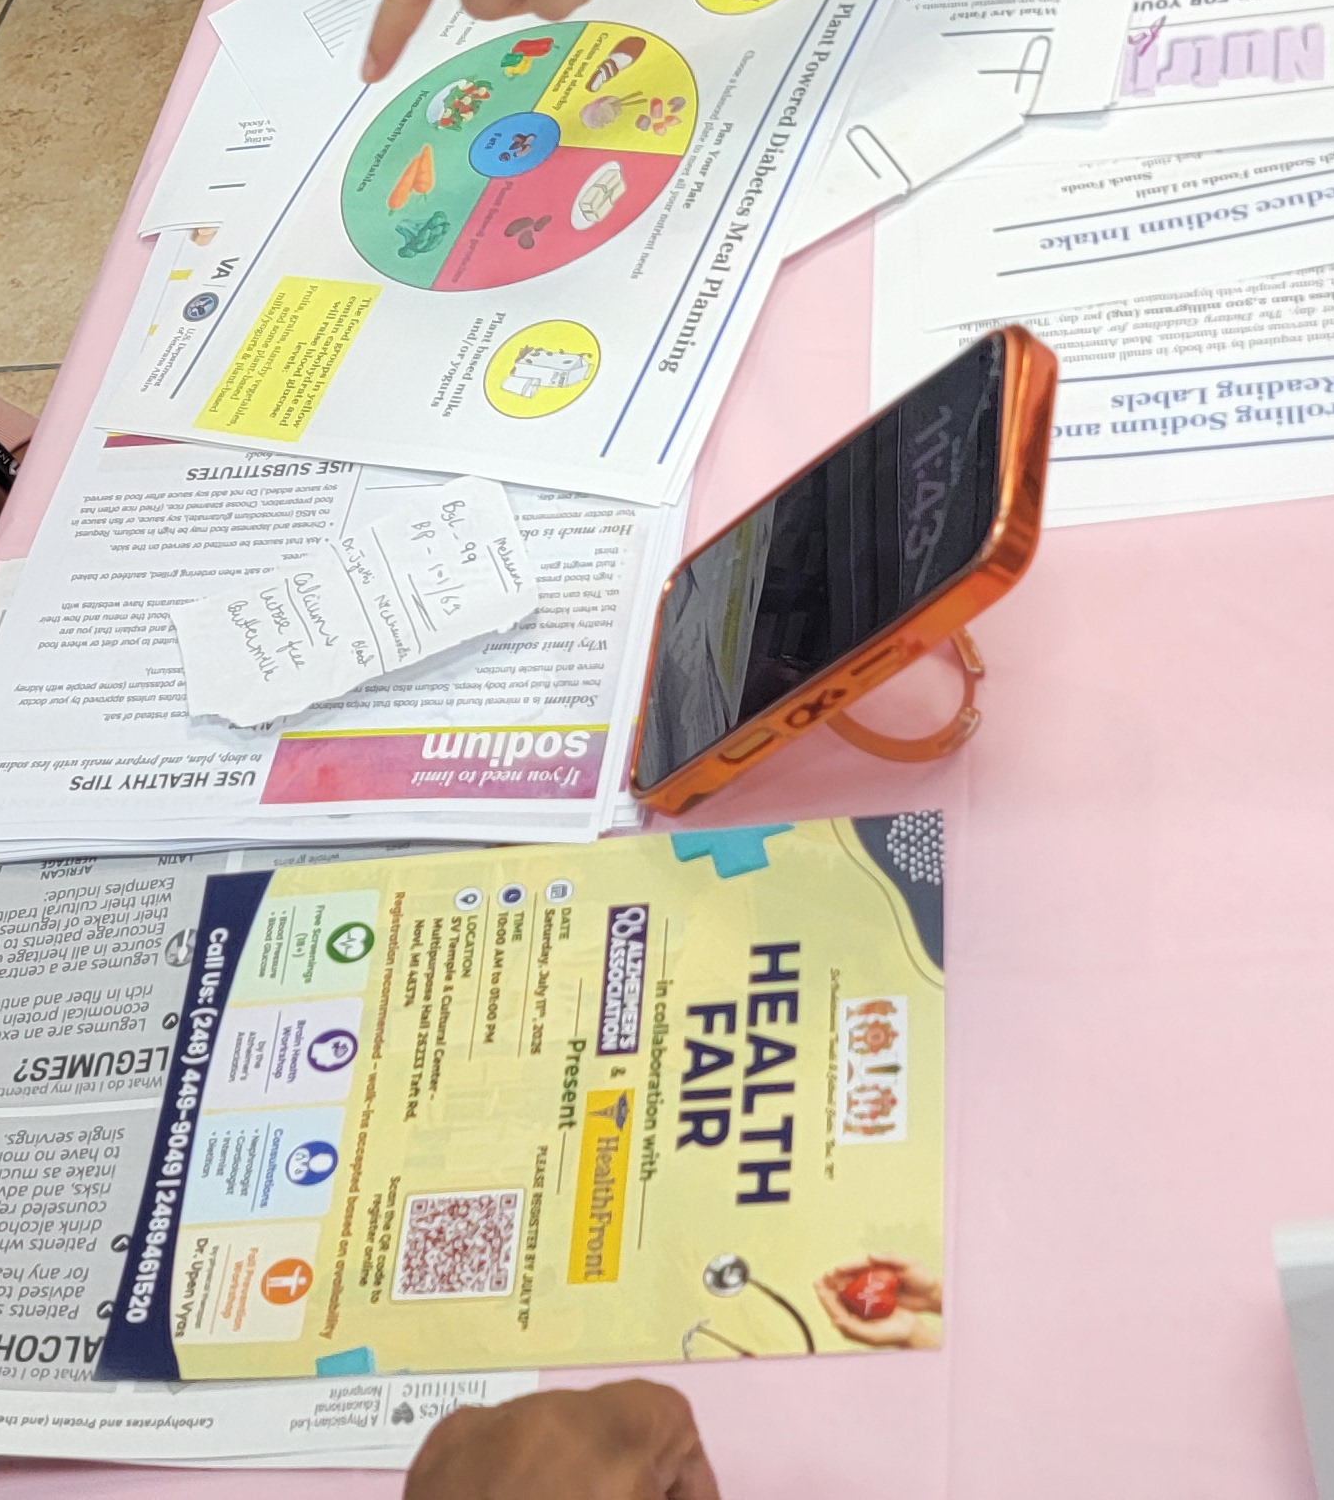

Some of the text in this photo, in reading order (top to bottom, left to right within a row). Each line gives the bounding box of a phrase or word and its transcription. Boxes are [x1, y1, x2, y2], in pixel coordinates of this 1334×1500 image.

[682, 122, 735, 210] Plan Your Plate
[658, 3, 856, 374] Plant Powered Diabetes Meal Planning
[1138, 203, 1249, 234] Sodium
[1039, 225, 1130, 251] Intake
[210, 257, 240, 280] VA
[140, 326, 185, 393] of Veterans Affairs
[153, 328, 197, 387] U.S. Department
[278, 295, 357, 427] contain carbohydrate and
[292, 296, 373, 429] The food groups in yellow
[430, 317, 484, 408] and/or yogurts
[441, 311, 507, 418] Plant based milks
[1110, 387, 1208, 413] Labels
[1110, 411, 1228, 436] Sodium
[185, 458, 356, 481] USE SUBSTITUTES
[479, 636, 608, 655] Why limit sodium?
[419, 730, 589, 766] sodium
[68, 770, 256, 791] USE HEALTHY TIPS
[410, 765, 582, 789] If you need to limit
[450, 915, 463, 933] SV
[511, 910, 525, 943] TIME
[558, 906, 572, 941] DATE
[203, 927, 229, 970] Call
[443, 934, 461, 982] Temple
[460, 914, 479, 979] LOCATION
[197, 971, 222, 1005] Us:
[442, 984, 455, 993] &
[482, 911, 510, 1044] 10:00 AM to 01:00 PM
[601, 935, 629, 1051] ASSOCIATION
[180, 1007, 218, 1065] (248)
[435, 994, 453, 1047] Cultural
[13, 1045, 172, 1083] LEGUMES?
[428, 1048, 446, 1093] Center
[638, 979, 674, 1182] in collaboration with
[675, 1001, 738, 1150] FAIR
[736, 941, 801, 1206] HEALTH
[558, 1039, 587, 1130] Present
[259, 1128, 284, 1209] Consultations
[582, 1134, 620, 1281] HealthFront
[27, 1262, 61, 1280] any
[62, 1266, 90, 1284] for
[16, 1285, 86, 1302] advised
[174, 1237, 209, 1339] Dr. Upen Vyas
[8, 1303, 80, 1321] Patients
[20, 1367, 27, 1381] I
[30, 1367, 51, 1382] do
[52, 1368, 95, 1383] What
[401, 1379, 487, 1400] Institute
[313, 1398, 381, 1416] Educational
[328, 1384, 383, 1401] Nonprofit
[19, 1414, 50, 1427] (and
[51, 1417, 97, 1429] Protein
[98, 1418, 123, 1430] and
[125, 1415, 214, 1430] Carbohydrates
[289, 1413, 379, 1433] A Physician-Led
